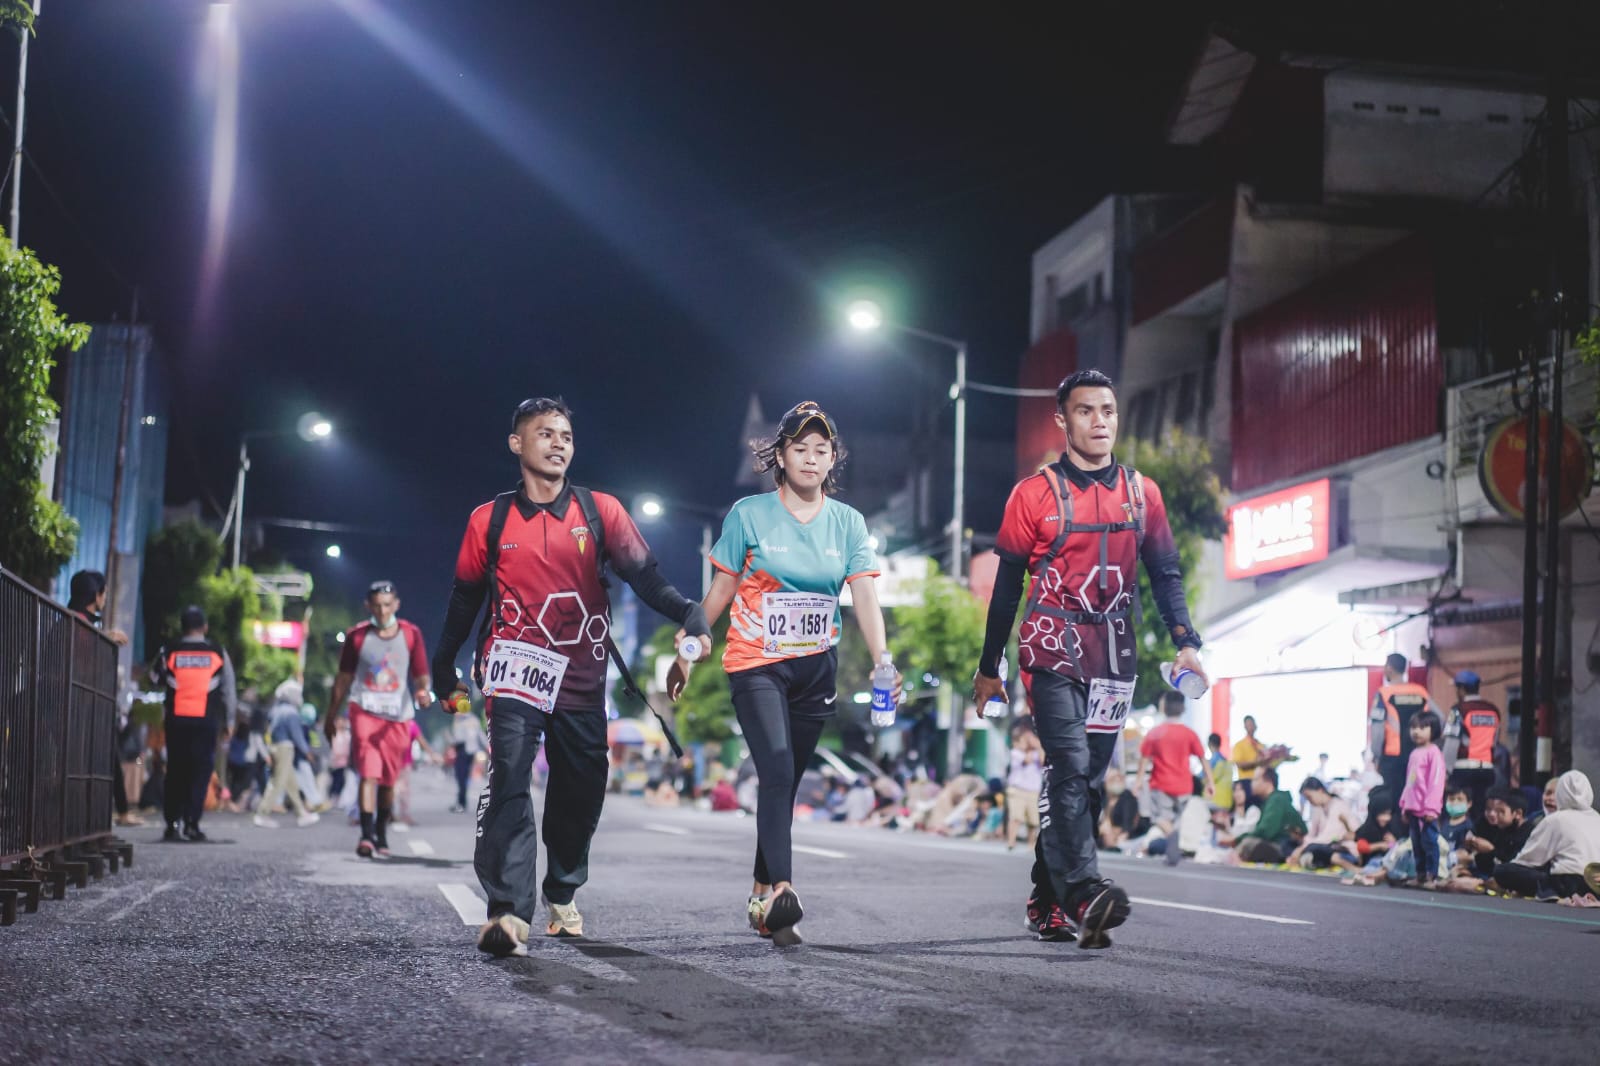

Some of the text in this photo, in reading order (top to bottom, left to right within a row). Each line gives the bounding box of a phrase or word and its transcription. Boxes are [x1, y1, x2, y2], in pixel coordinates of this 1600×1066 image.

[768, 614, 787, 636] 02
[800, 613, 828, 636] 1581
[510, 650, 540, 662] TAJEMTRA
[540, 659, 554, 668] 2022
[490, 660, 508, 682] 01
[521, 665, 557, 697] 1064
